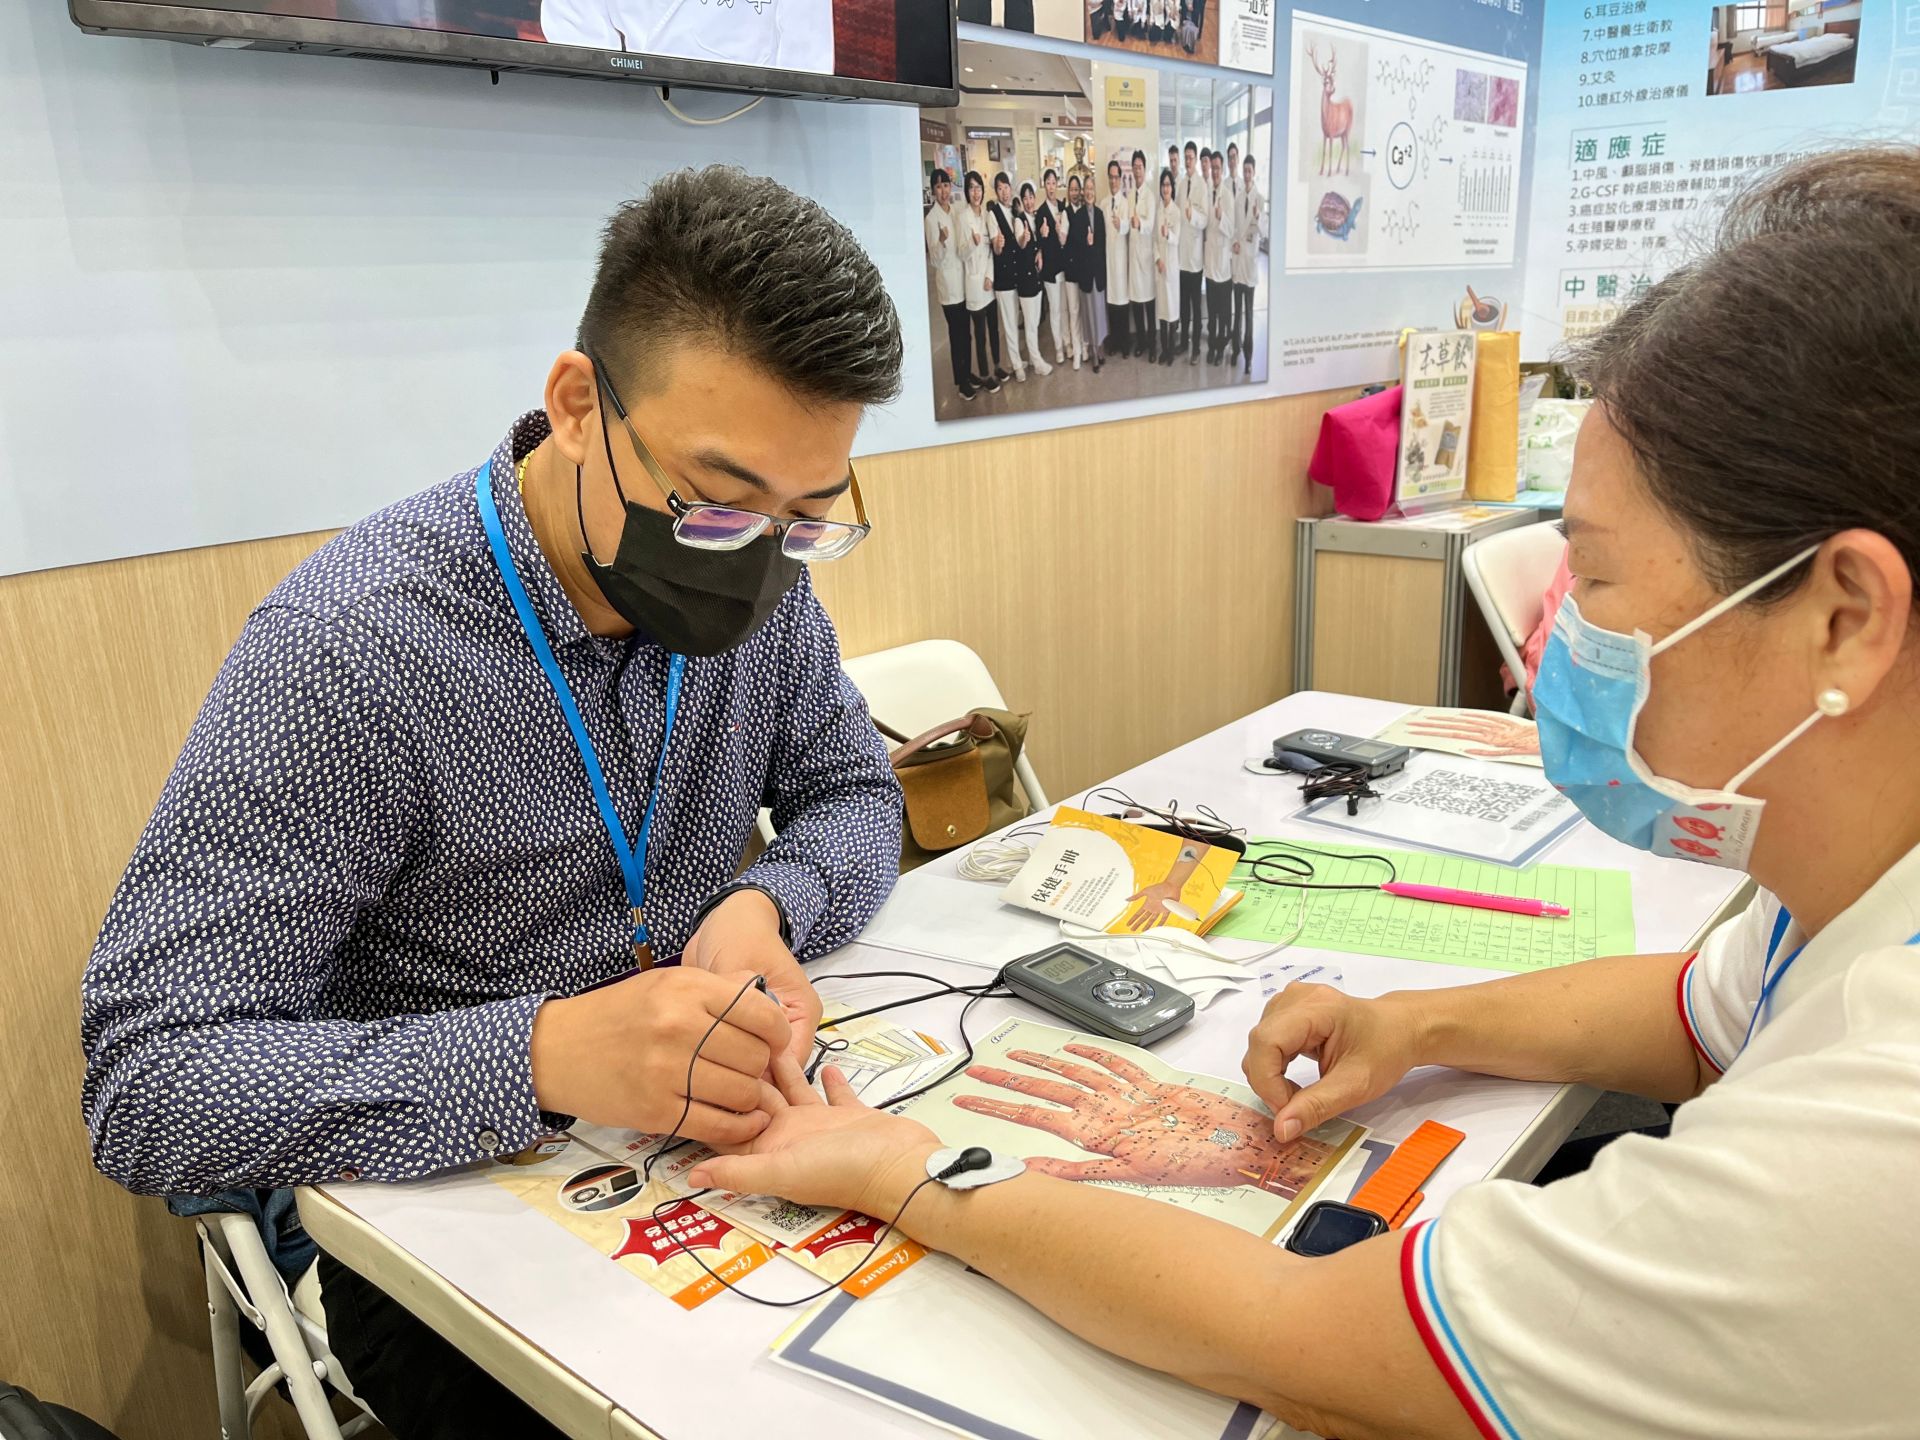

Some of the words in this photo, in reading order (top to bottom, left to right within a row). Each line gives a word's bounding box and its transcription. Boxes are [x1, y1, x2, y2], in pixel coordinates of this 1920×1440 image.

[1584, 0, 1647, 19] 6.耳豆治療
[1582, 20, 1672, 41] 7.中醫養生衛教
[611, 57, 643, 70] CHIMEI
[1580, 42, 1671, 64] 8.穴位推拿按摩
[1579, 70, 1615, 86] 9.艾灸
[1578, 84, 1689, 108] 10.遠紅外線治療儀
[1575, 132, 1666, 163] 適應症
[1570, 184, 1619, 199] 2.G-CSF
[1031, 849, 1080, 902] 保健手冊
